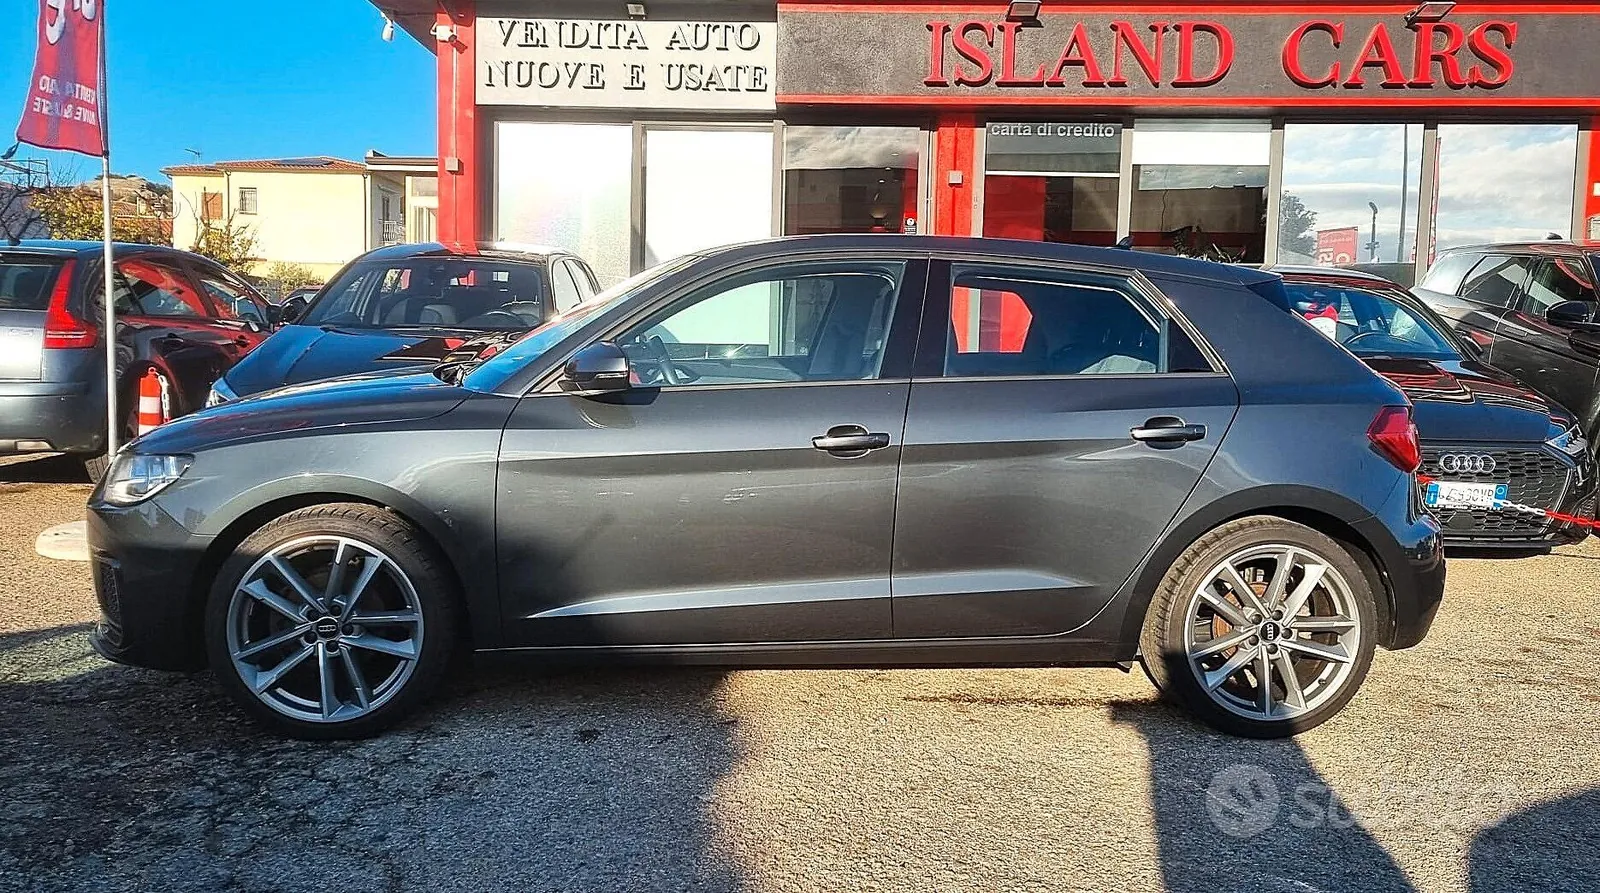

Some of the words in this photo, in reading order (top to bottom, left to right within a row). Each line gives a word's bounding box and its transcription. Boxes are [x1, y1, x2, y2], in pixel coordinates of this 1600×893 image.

[493, 20, 649, 49] VENDITA
[665, 23, 761, 51] AUTO
[924, 19, 1234, 87] ISLAND
[1281, 20, 1518, 89] CARS
[485, 60, 605, 89] NUOVE
[622, 63, 645, 91] E
[660, 63, 768, 92] USATE
[991, 123, 1032, 136] carta
[1037, 123, 1052, 136] di
[1057, 123, 1115, 138] credito
